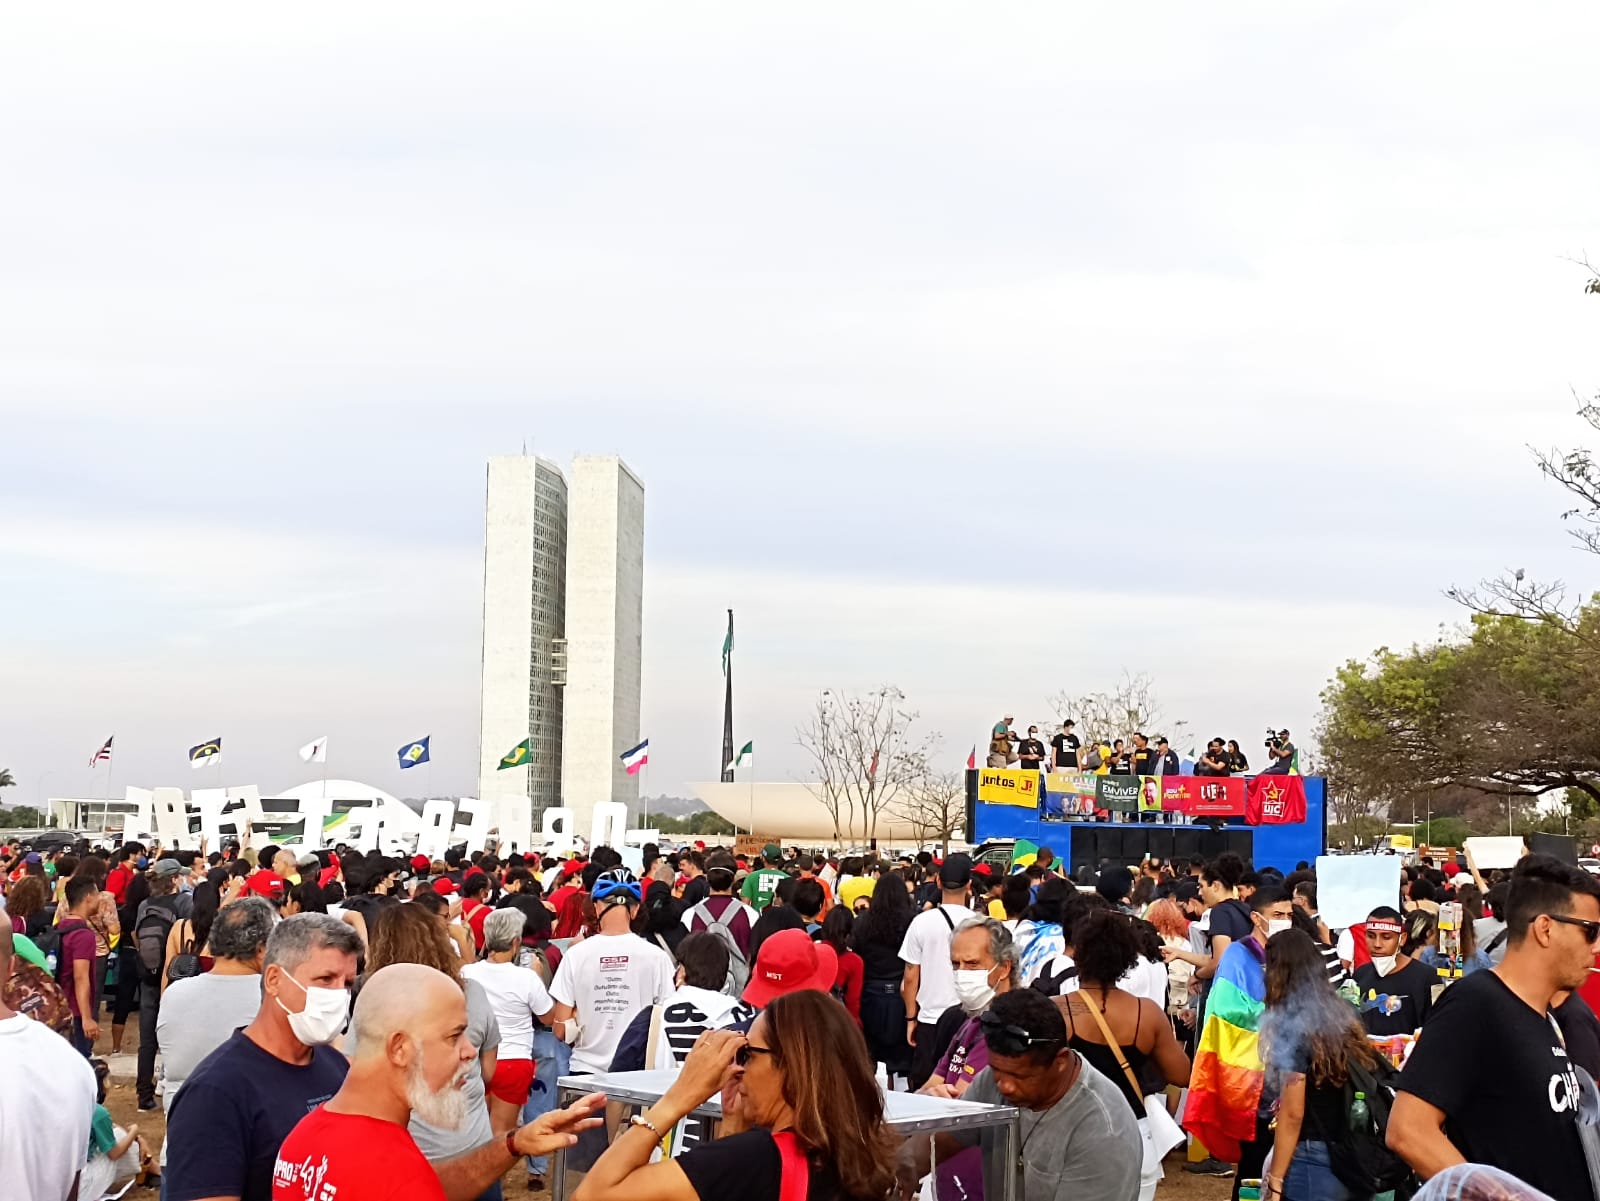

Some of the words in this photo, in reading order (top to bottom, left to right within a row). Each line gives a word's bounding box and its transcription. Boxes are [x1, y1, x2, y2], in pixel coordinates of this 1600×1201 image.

[980, 774, 1015, 788] juntos
[1264, 805, 1281, 815] UJC
[766, 971, 783, 981] MST
